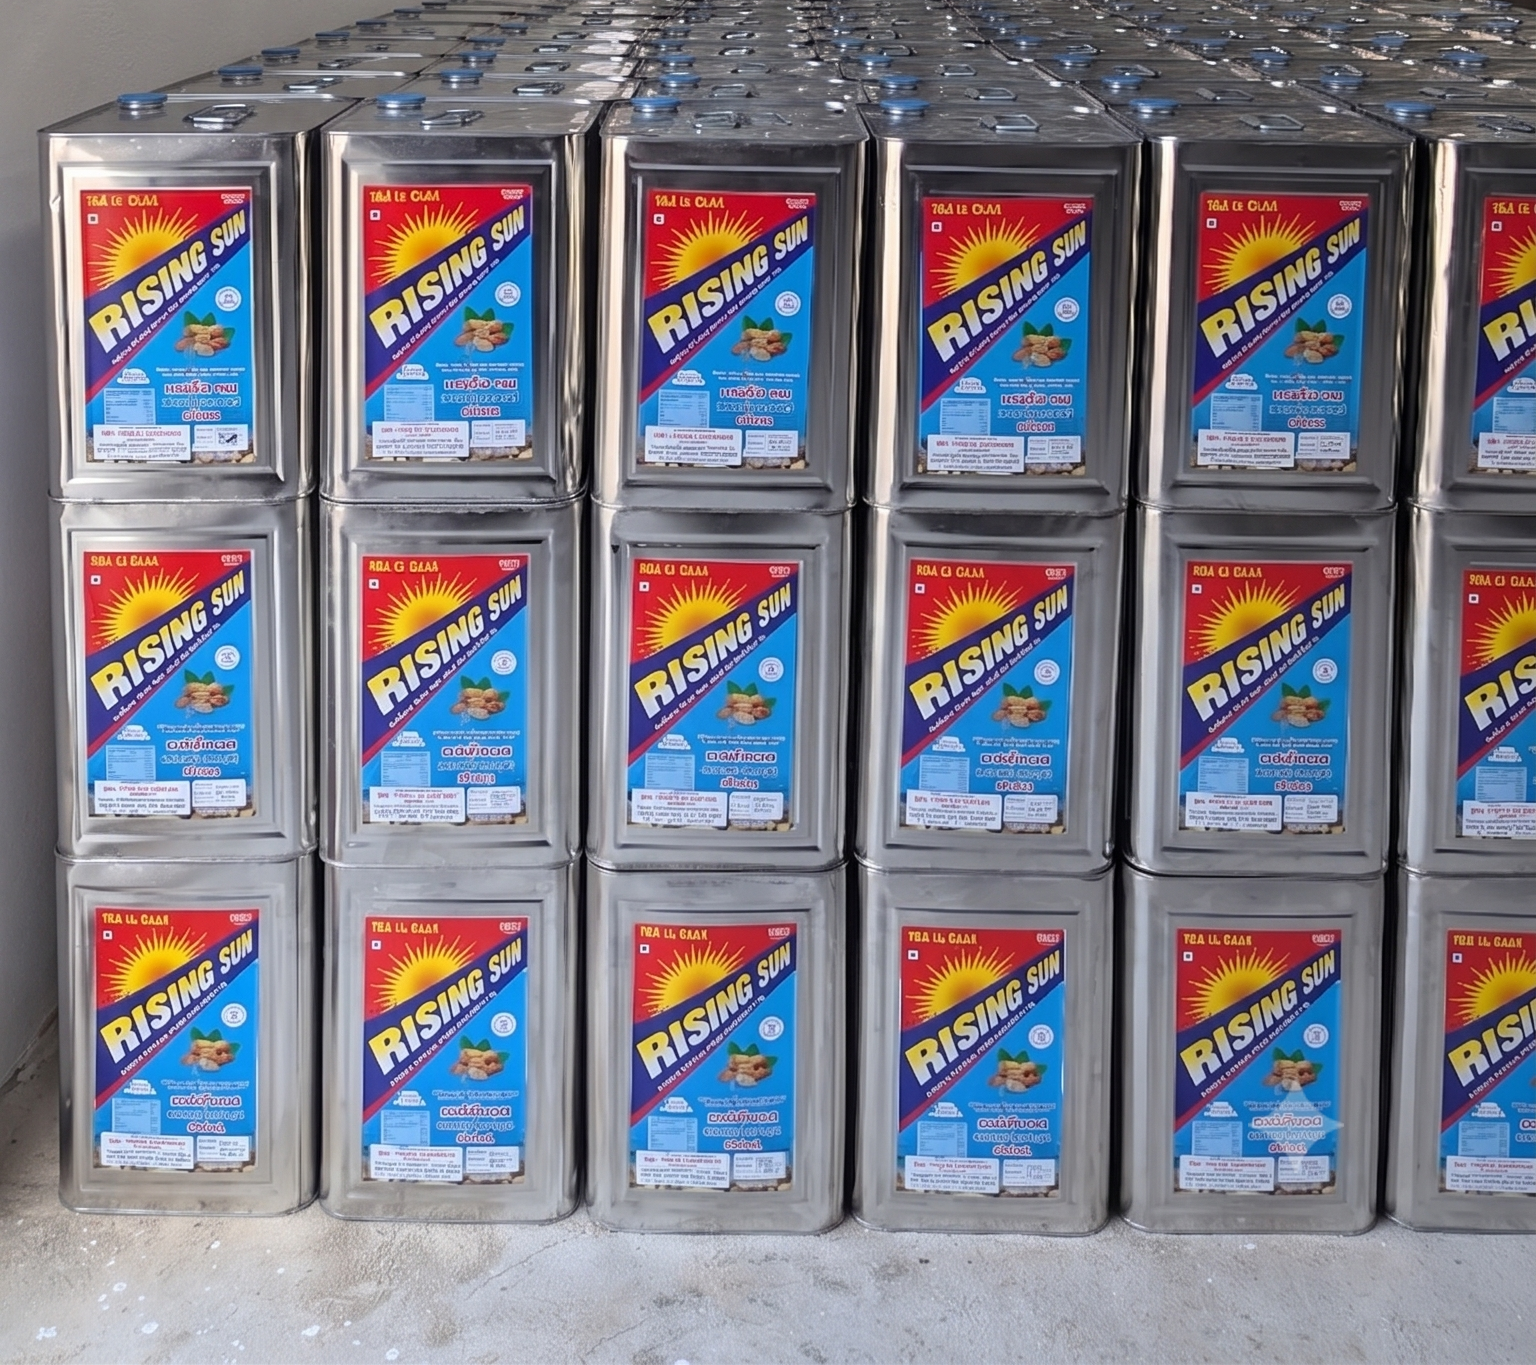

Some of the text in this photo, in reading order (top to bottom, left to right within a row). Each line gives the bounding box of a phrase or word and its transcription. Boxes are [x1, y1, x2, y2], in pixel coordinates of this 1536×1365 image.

[88, 209, 246, 354] RISING SUN
[368, 205, 525, 349] RISING SUN
[647, 215, 808, 354] RISING SUN
[927, 220, 1086, 363] RISING SUN
[1200, 217, 1360, 358] RISING SUN
[90, 569, 245, 711] RISING SUN
[366, 574, 522, 716] RISING SUN
[634, 582, 791, 719] RISING SUN
[908, 584, 1068, 721] RISING SUN
[1186, 583, 1345, 722] RISING SUN
[99, 928, 253, 1064] RISING SUN
[368, 937, 522, 1076] RISING SUN
[636, 941, 791, 1080] RISING SUN
[904, 949, 1060, 1086] RISING SUN
[1179, 949, 1335, 1087] RISING SUN
